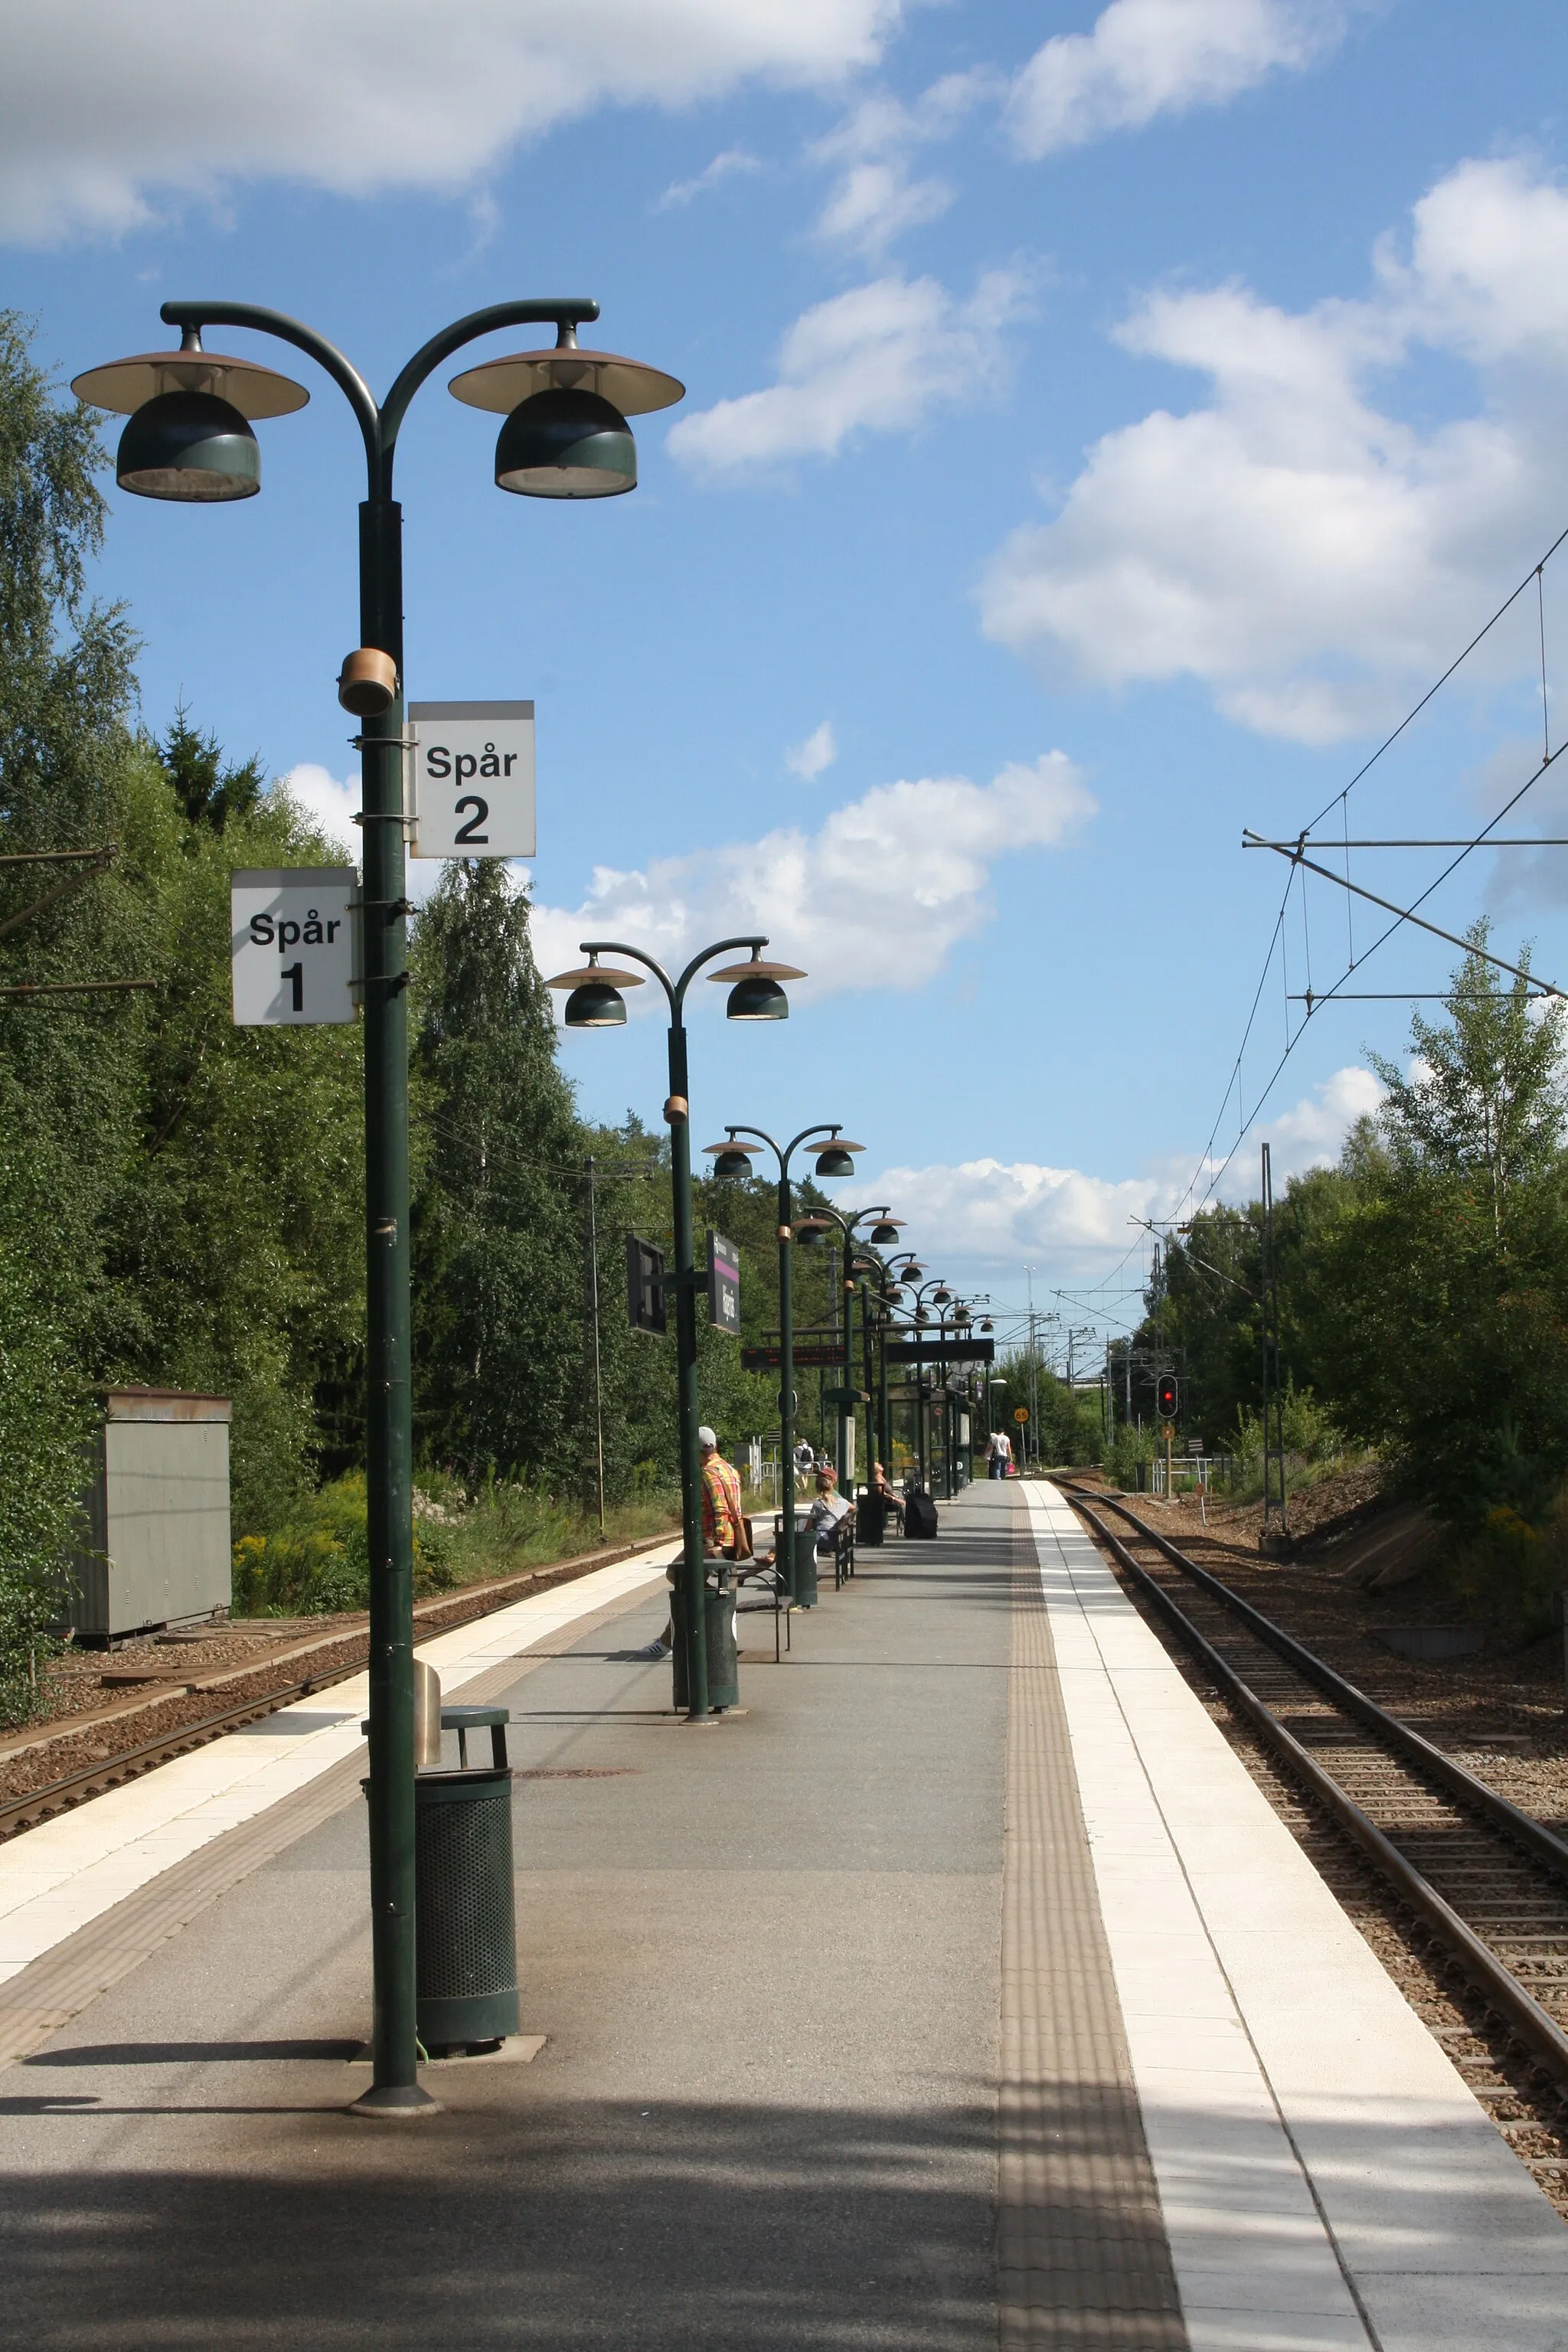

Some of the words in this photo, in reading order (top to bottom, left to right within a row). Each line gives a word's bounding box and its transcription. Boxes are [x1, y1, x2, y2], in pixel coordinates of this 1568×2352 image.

[427, 743, 517, 786] Spår
[455, 796, 488, 844] 2
[250, 910, 340, 952] Spår
[281, 963, 303, 1011] 1
